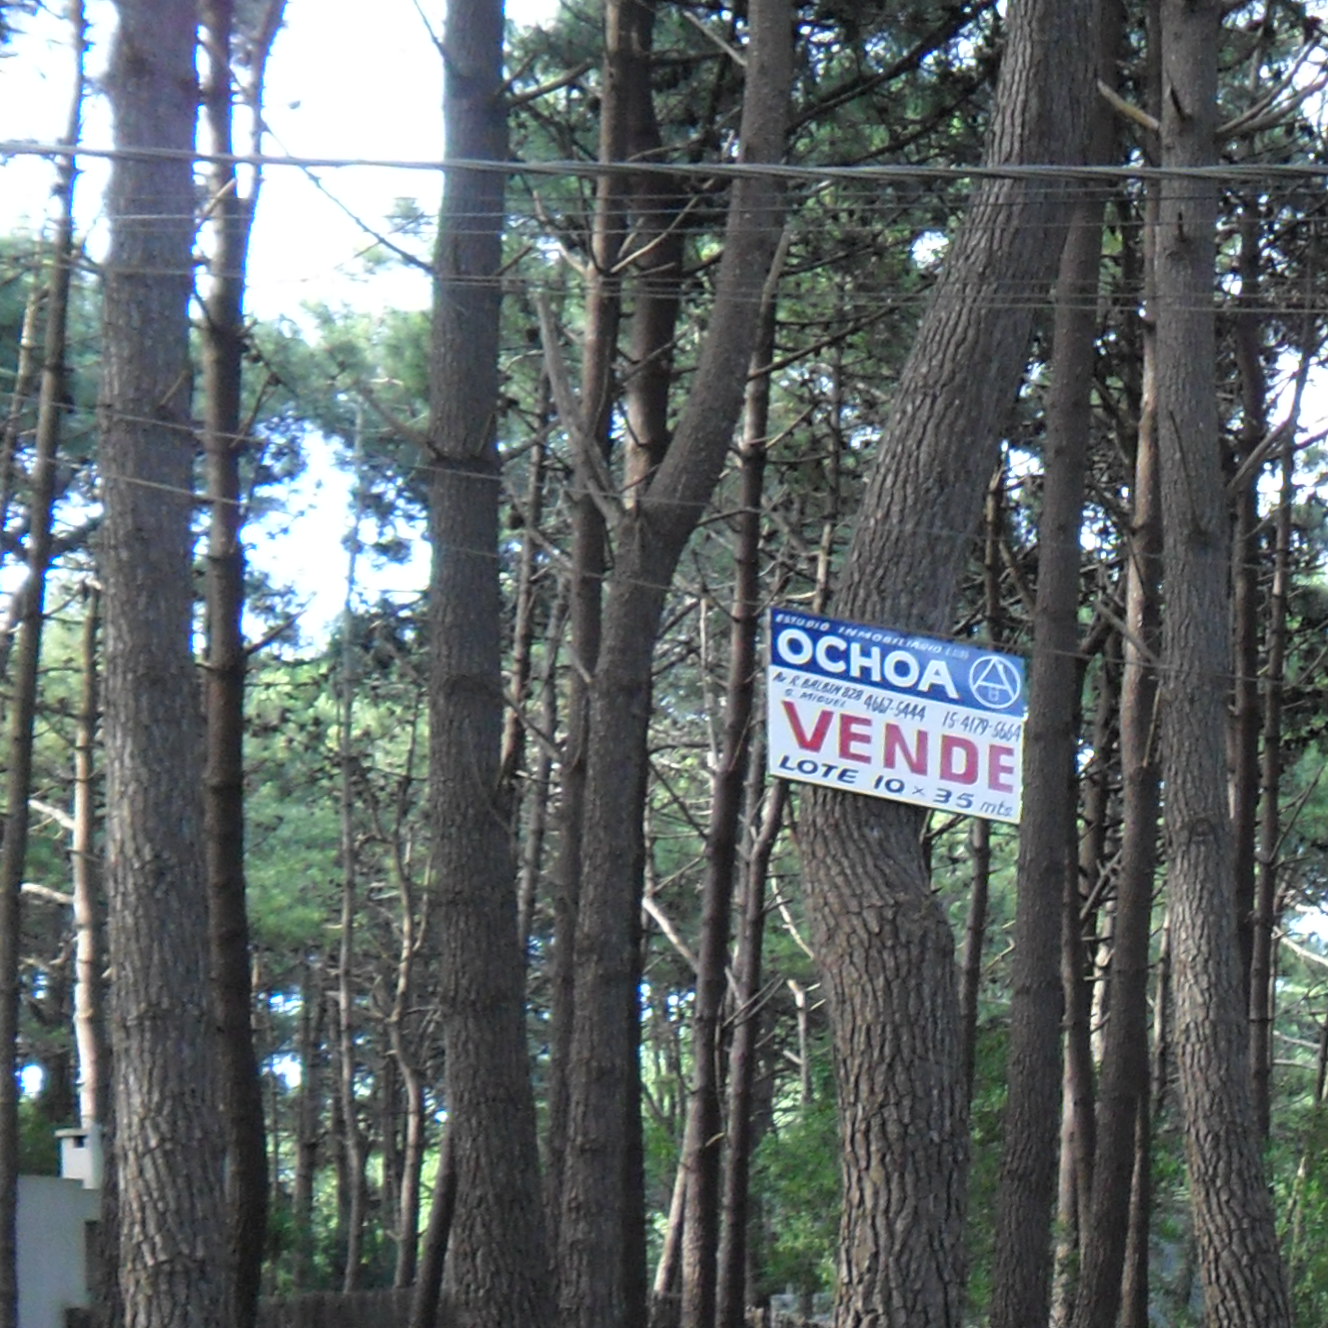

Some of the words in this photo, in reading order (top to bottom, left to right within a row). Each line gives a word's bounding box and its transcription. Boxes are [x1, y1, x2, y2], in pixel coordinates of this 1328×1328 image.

[777, 628, 960, 699] OCHOA
[779, 755, 859, 784] LOTE
[874, 775, 905, 794] 10
[933, 787, 975, 809] 35
[781, 700, 1015, 794] VENDE
